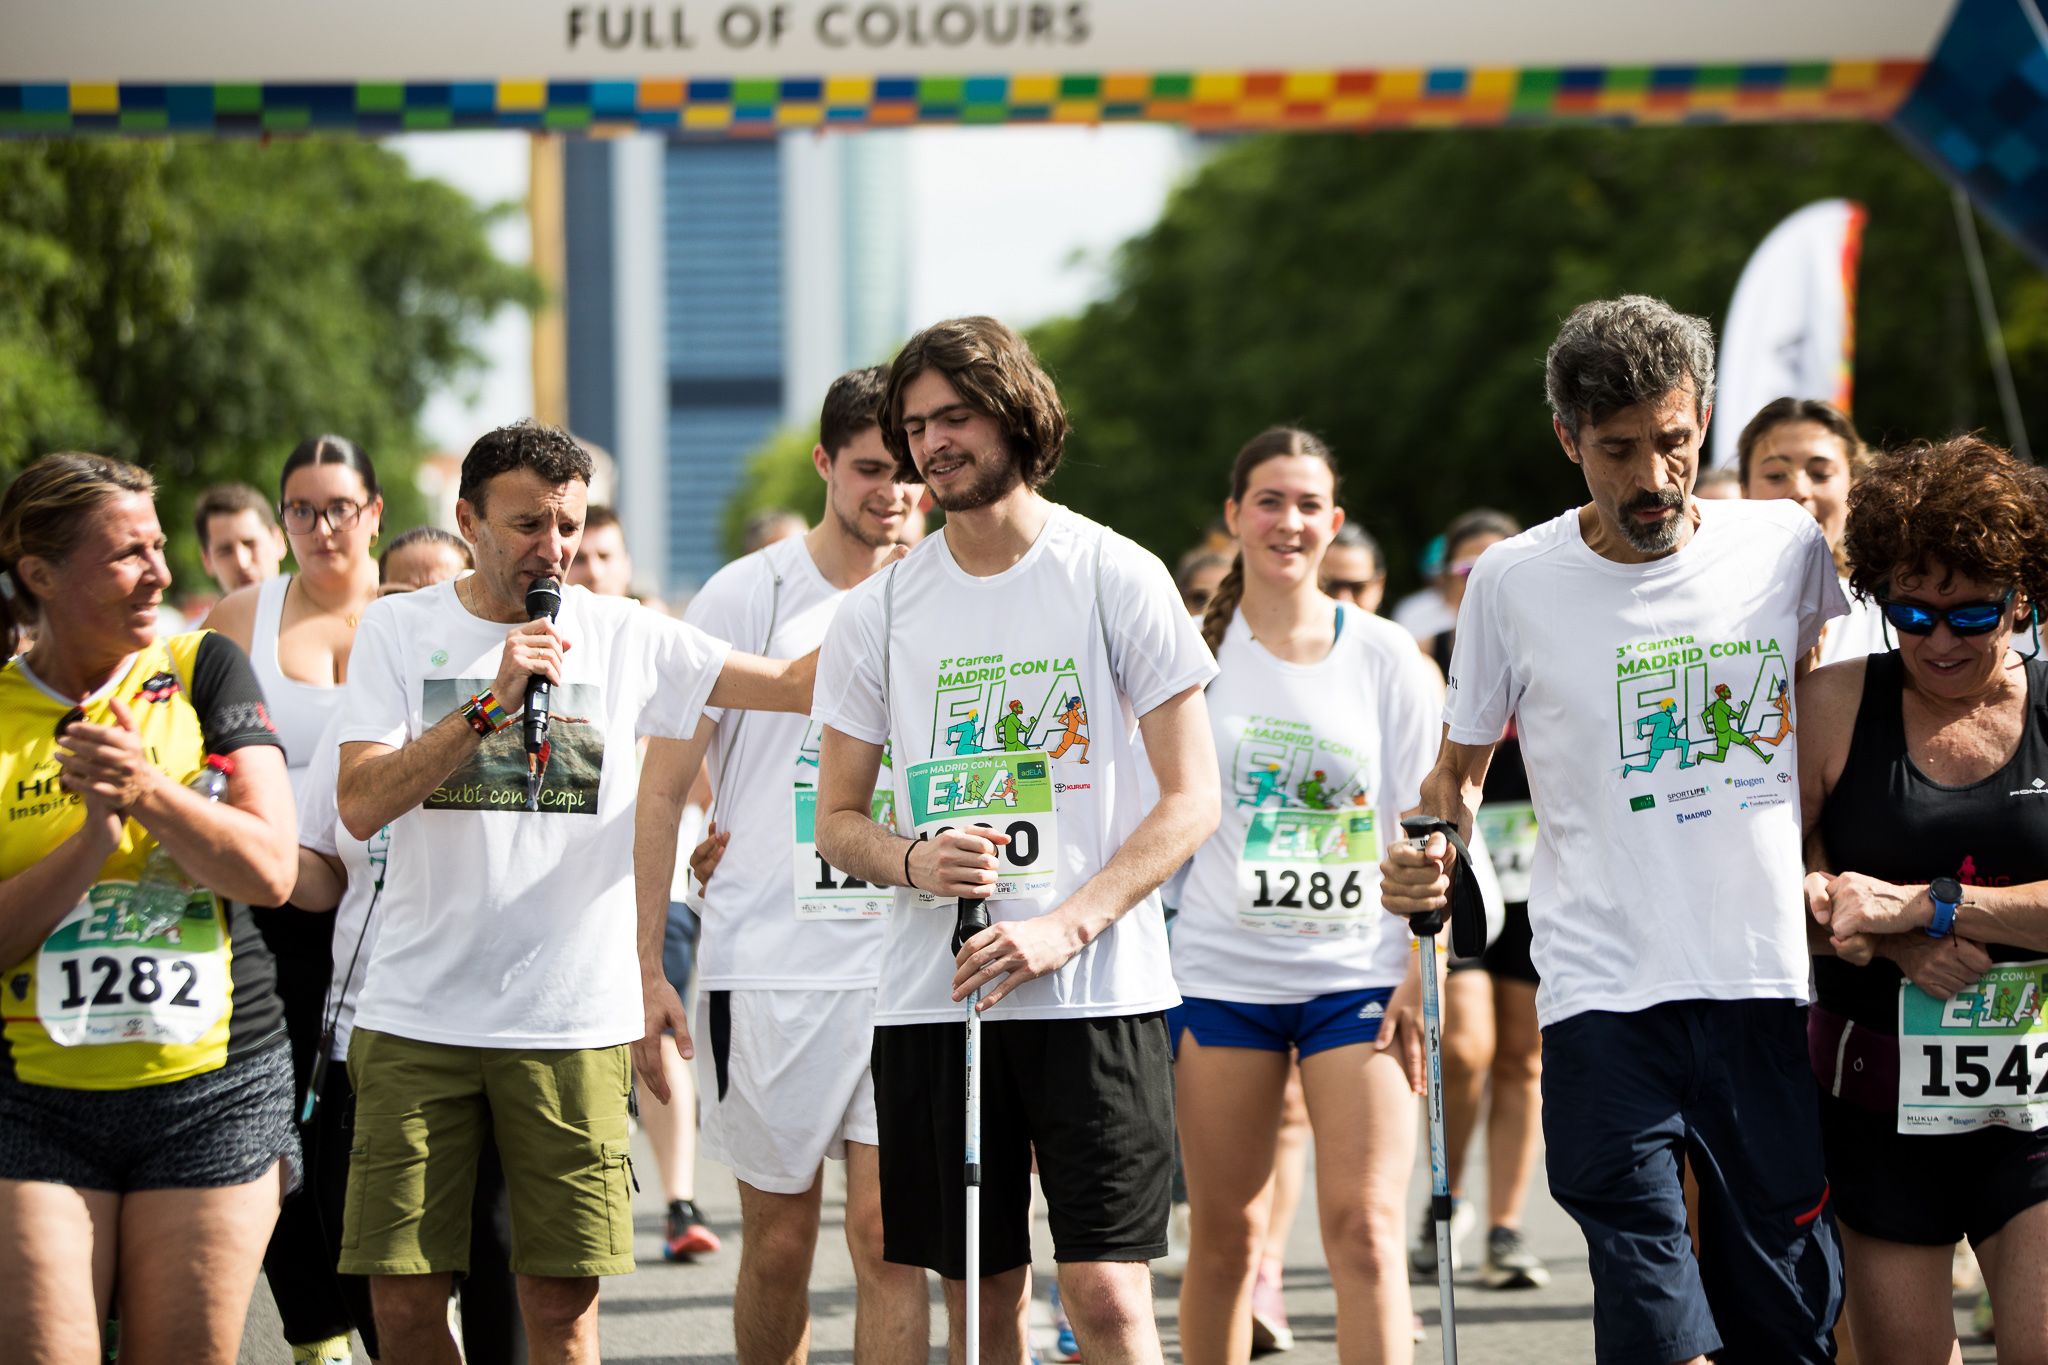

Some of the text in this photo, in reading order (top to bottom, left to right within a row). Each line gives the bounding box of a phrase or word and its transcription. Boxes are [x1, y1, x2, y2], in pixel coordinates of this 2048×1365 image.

[566, 1, 1094, 51] FULL OF COLOURS
[1616, 638, 1780, 678] MADRID CON LA
[1636, 635, 1695, 653] Carrera
[937, 657, 1076, 688] MADRID CON LA
[956, 654, 1004, 668] Carrera
[930, 672, 1091, 759] ELA
[1617, 655, 1793, 761] ELA
[929, 762, 969, 775] MADRID
[971, 760, 992, 769] CON
[995, 760, 1008, 768] LA
[1734, 777, 1765, 788] Biogen
[430, 783, 586, 814] Subí con Capi
[926, 769, 1017, 815] ELA
[1684, 809, 1712, 821] MADRID
[1268, 824, 1349, 857] ELA
[1253, 870, 1363, 911] 1286
[60, 955, 201, 1010] 1282
[2000, 972, 2025, 981] CON
[2025, 971, 2035, 980] LA
[1940, 982, 2041, 1029] ELA
